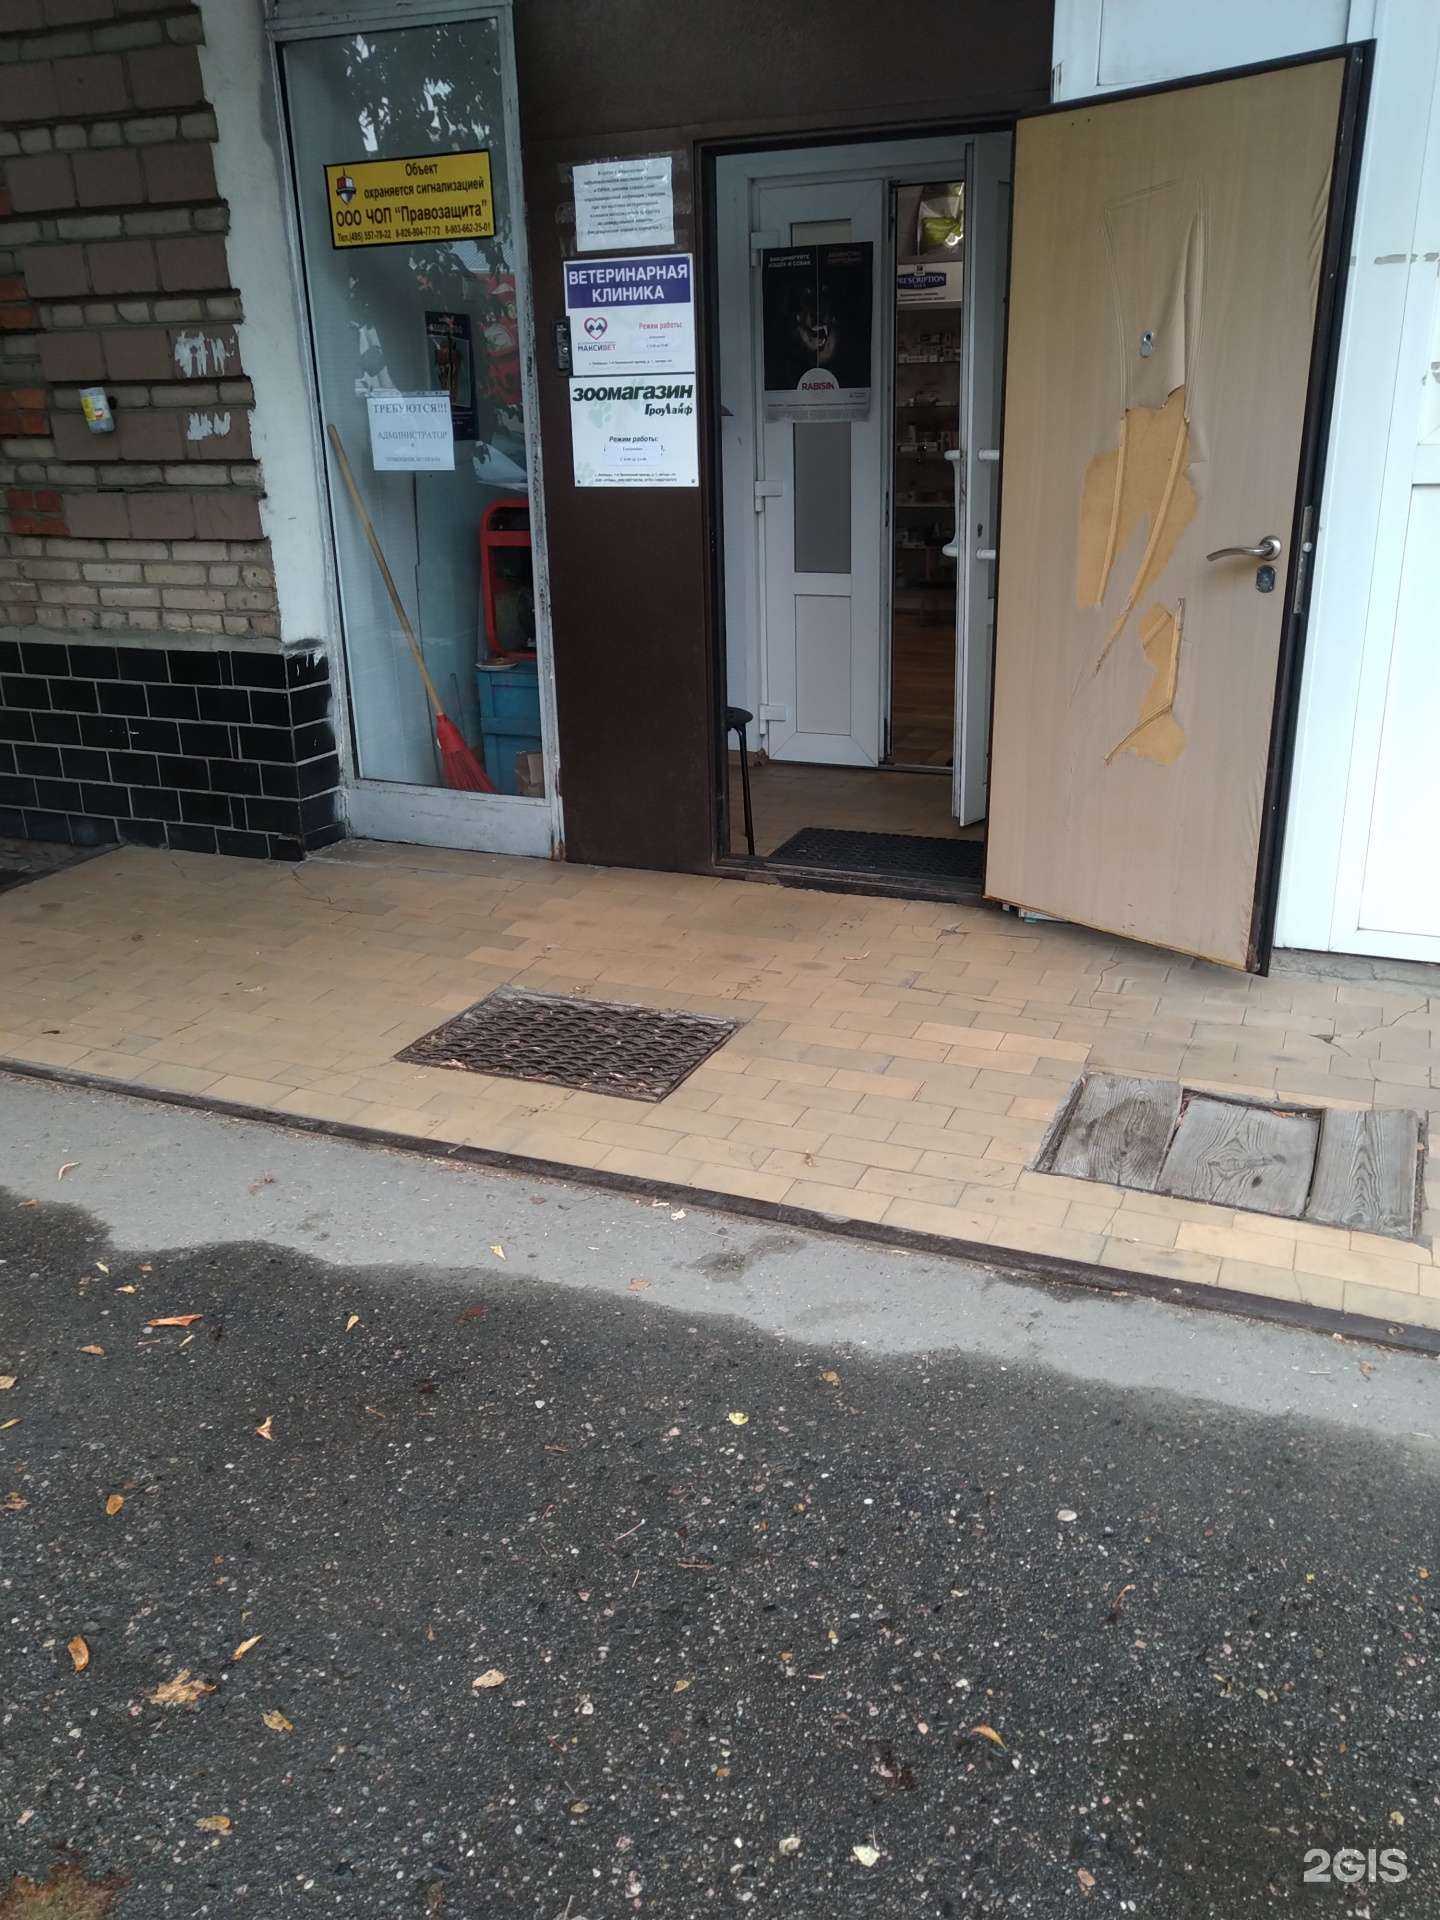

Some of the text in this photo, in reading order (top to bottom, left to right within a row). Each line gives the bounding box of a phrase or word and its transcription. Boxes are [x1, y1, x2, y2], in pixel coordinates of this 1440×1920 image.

[405, 163, 438, 176] Объект
[364, 176, 485, 200] охраняется сигнализацией
[336, 209, 362, 227] ООО
[365, 207, 392, 225] ЧОП
[568, 264, 688, 285] ВЕТЕРИНАРНАЯ
[592, 285, 664, 303] КЛИНИКА
[639, 322, 658, 330] Режим
[377, 431, 447, 440] АДМИНИСТРАТОР
